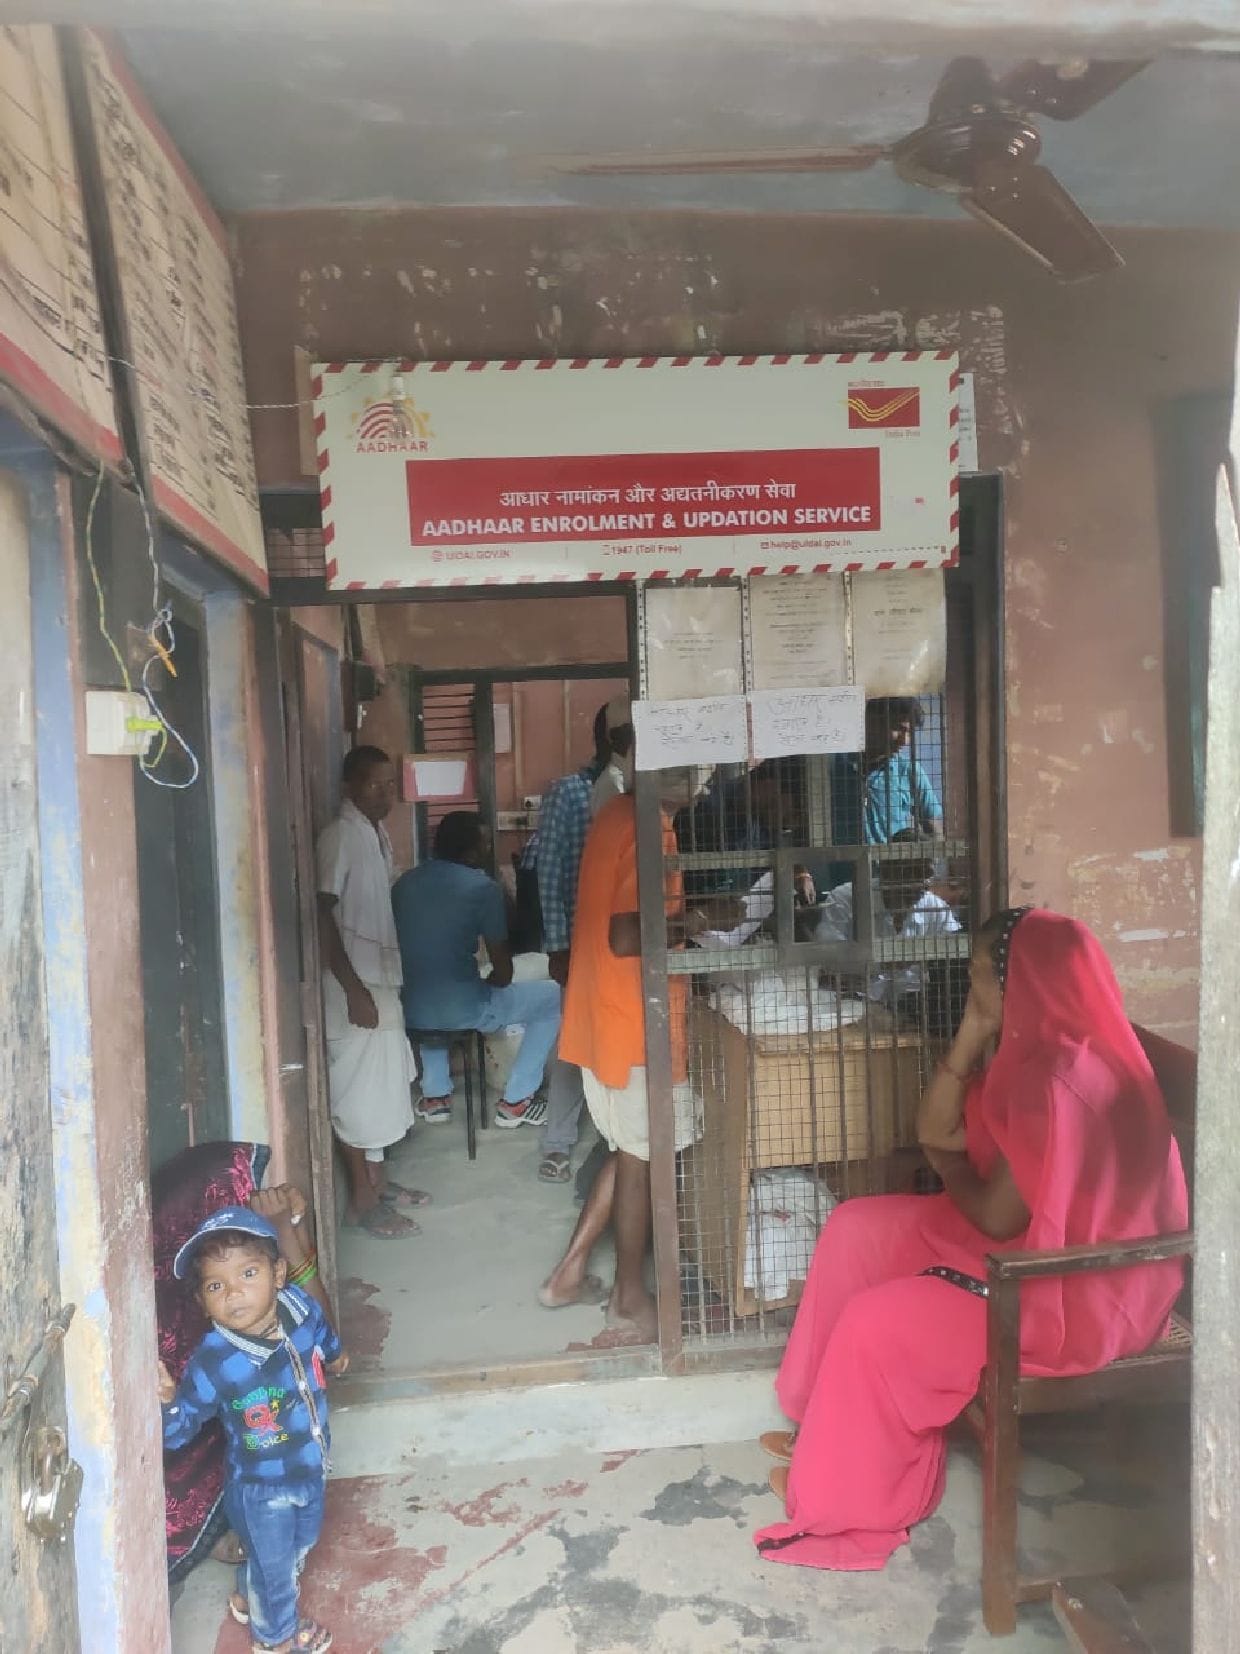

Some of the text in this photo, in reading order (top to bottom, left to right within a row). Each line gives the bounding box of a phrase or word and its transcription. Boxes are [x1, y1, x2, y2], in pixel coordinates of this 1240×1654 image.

[356, 441, 429, 453] AADHAAR
[500, 491, 550, 507] आधार
[556, 485, 620, 505] नामांकन
[626, 483, 655, 503] और
[765, 478, 797, 499] सेवा
[422, 506, 872, 537] AADHAAR ENROLMENT & UPDATION SERVICE
